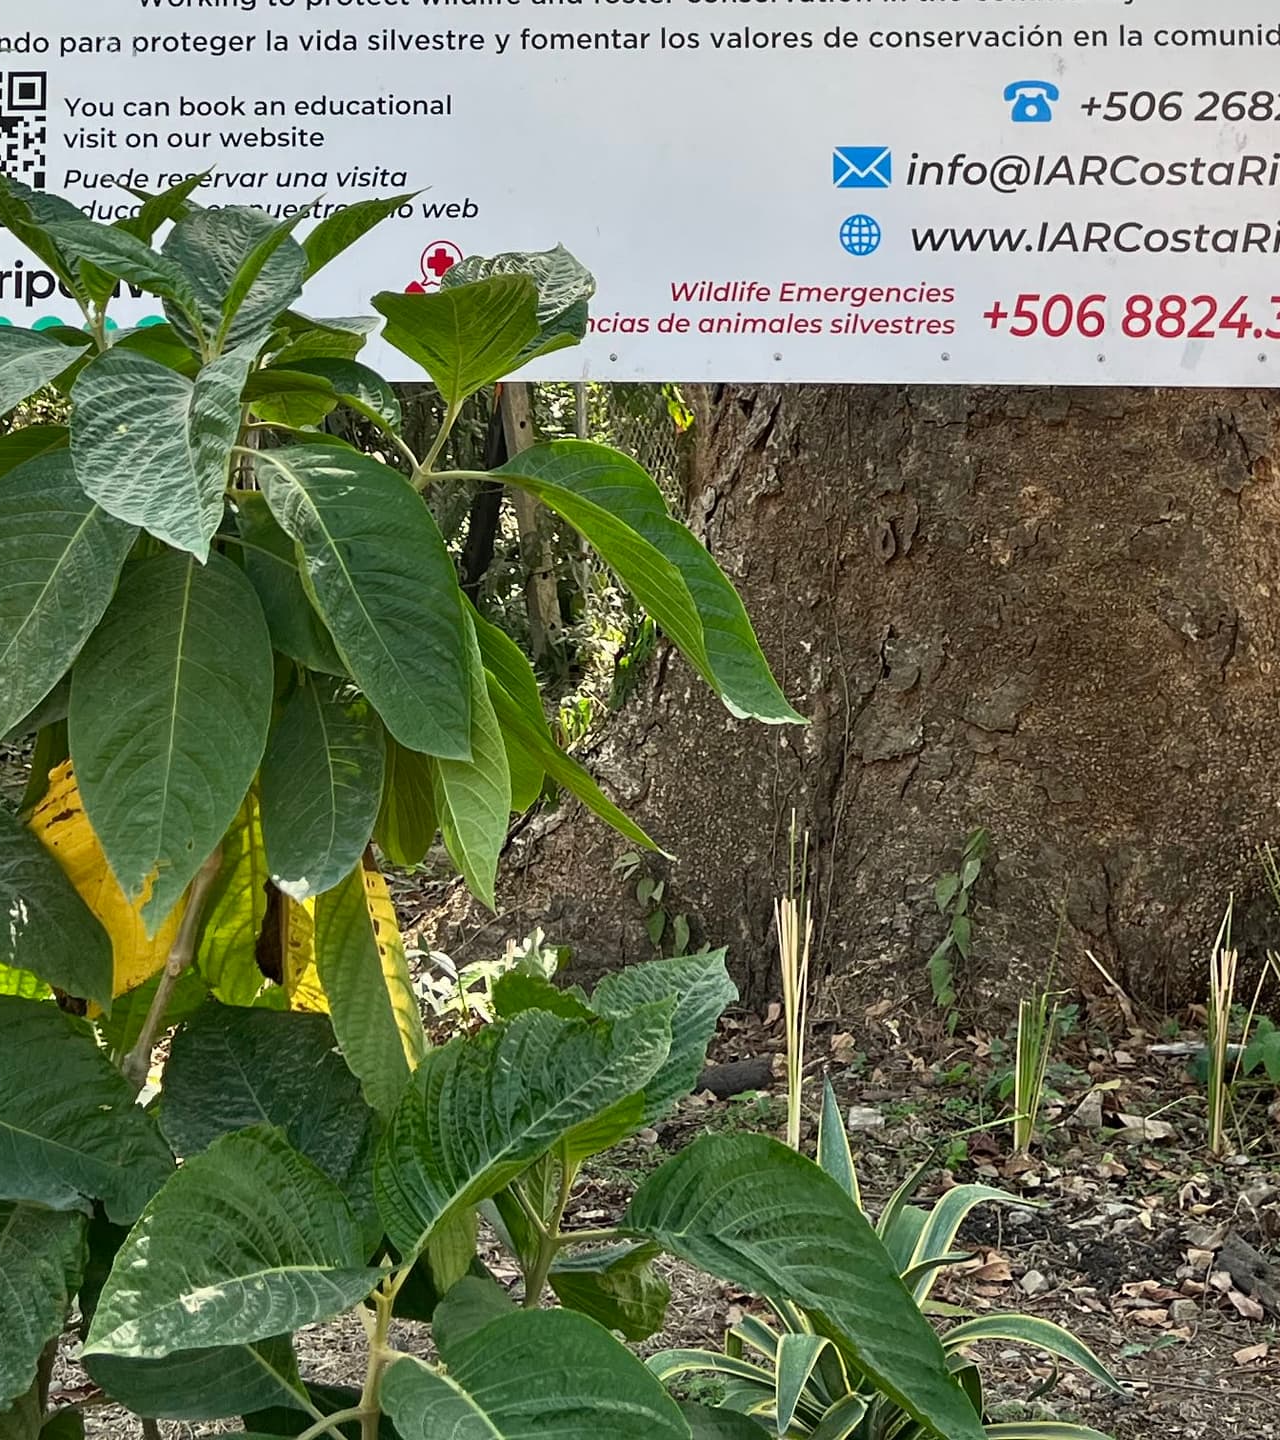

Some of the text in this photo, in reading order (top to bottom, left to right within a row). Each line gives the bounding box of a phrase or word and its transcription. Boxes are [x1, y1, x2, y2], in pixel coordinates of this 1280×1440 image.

[60, 36, 121, 58] para
[132, 31, 257, 57] proteger
[266, 29, 289, 52] la
[298, 28, 358, 52] vida
[367, 28, 485, 51] silvestre
[494, 33, 511, 55] y
[519, 27, 651, 50] fomentar
[661, 26, 700, 50] los
[709, 26, 813, 49] valores
[823, 25, 859, 49] de
[868, 24, 1063, 49] conservación
[1073, 30, 1108, 47] en
[1119, 24, 1143, 47] la
[63, 93, 452, 118] You can book an educational
[1080, 90, 1184, 122] +506
[63, 125, 325, 149] visit on our website
[63, 167, 149, 189] Puede
[276, 171, 328, 188] una
[336, 165, 408, 188] visita
[422, 197, 479, 219] web
[671, 280, 955, 308] Wildlife Emergencies
[657, 312, 691, 334] de
[698, 311, 823, 334] animales
[829, 312, 956, 335] silvestres
[983, 293, 1107, 338] +506
